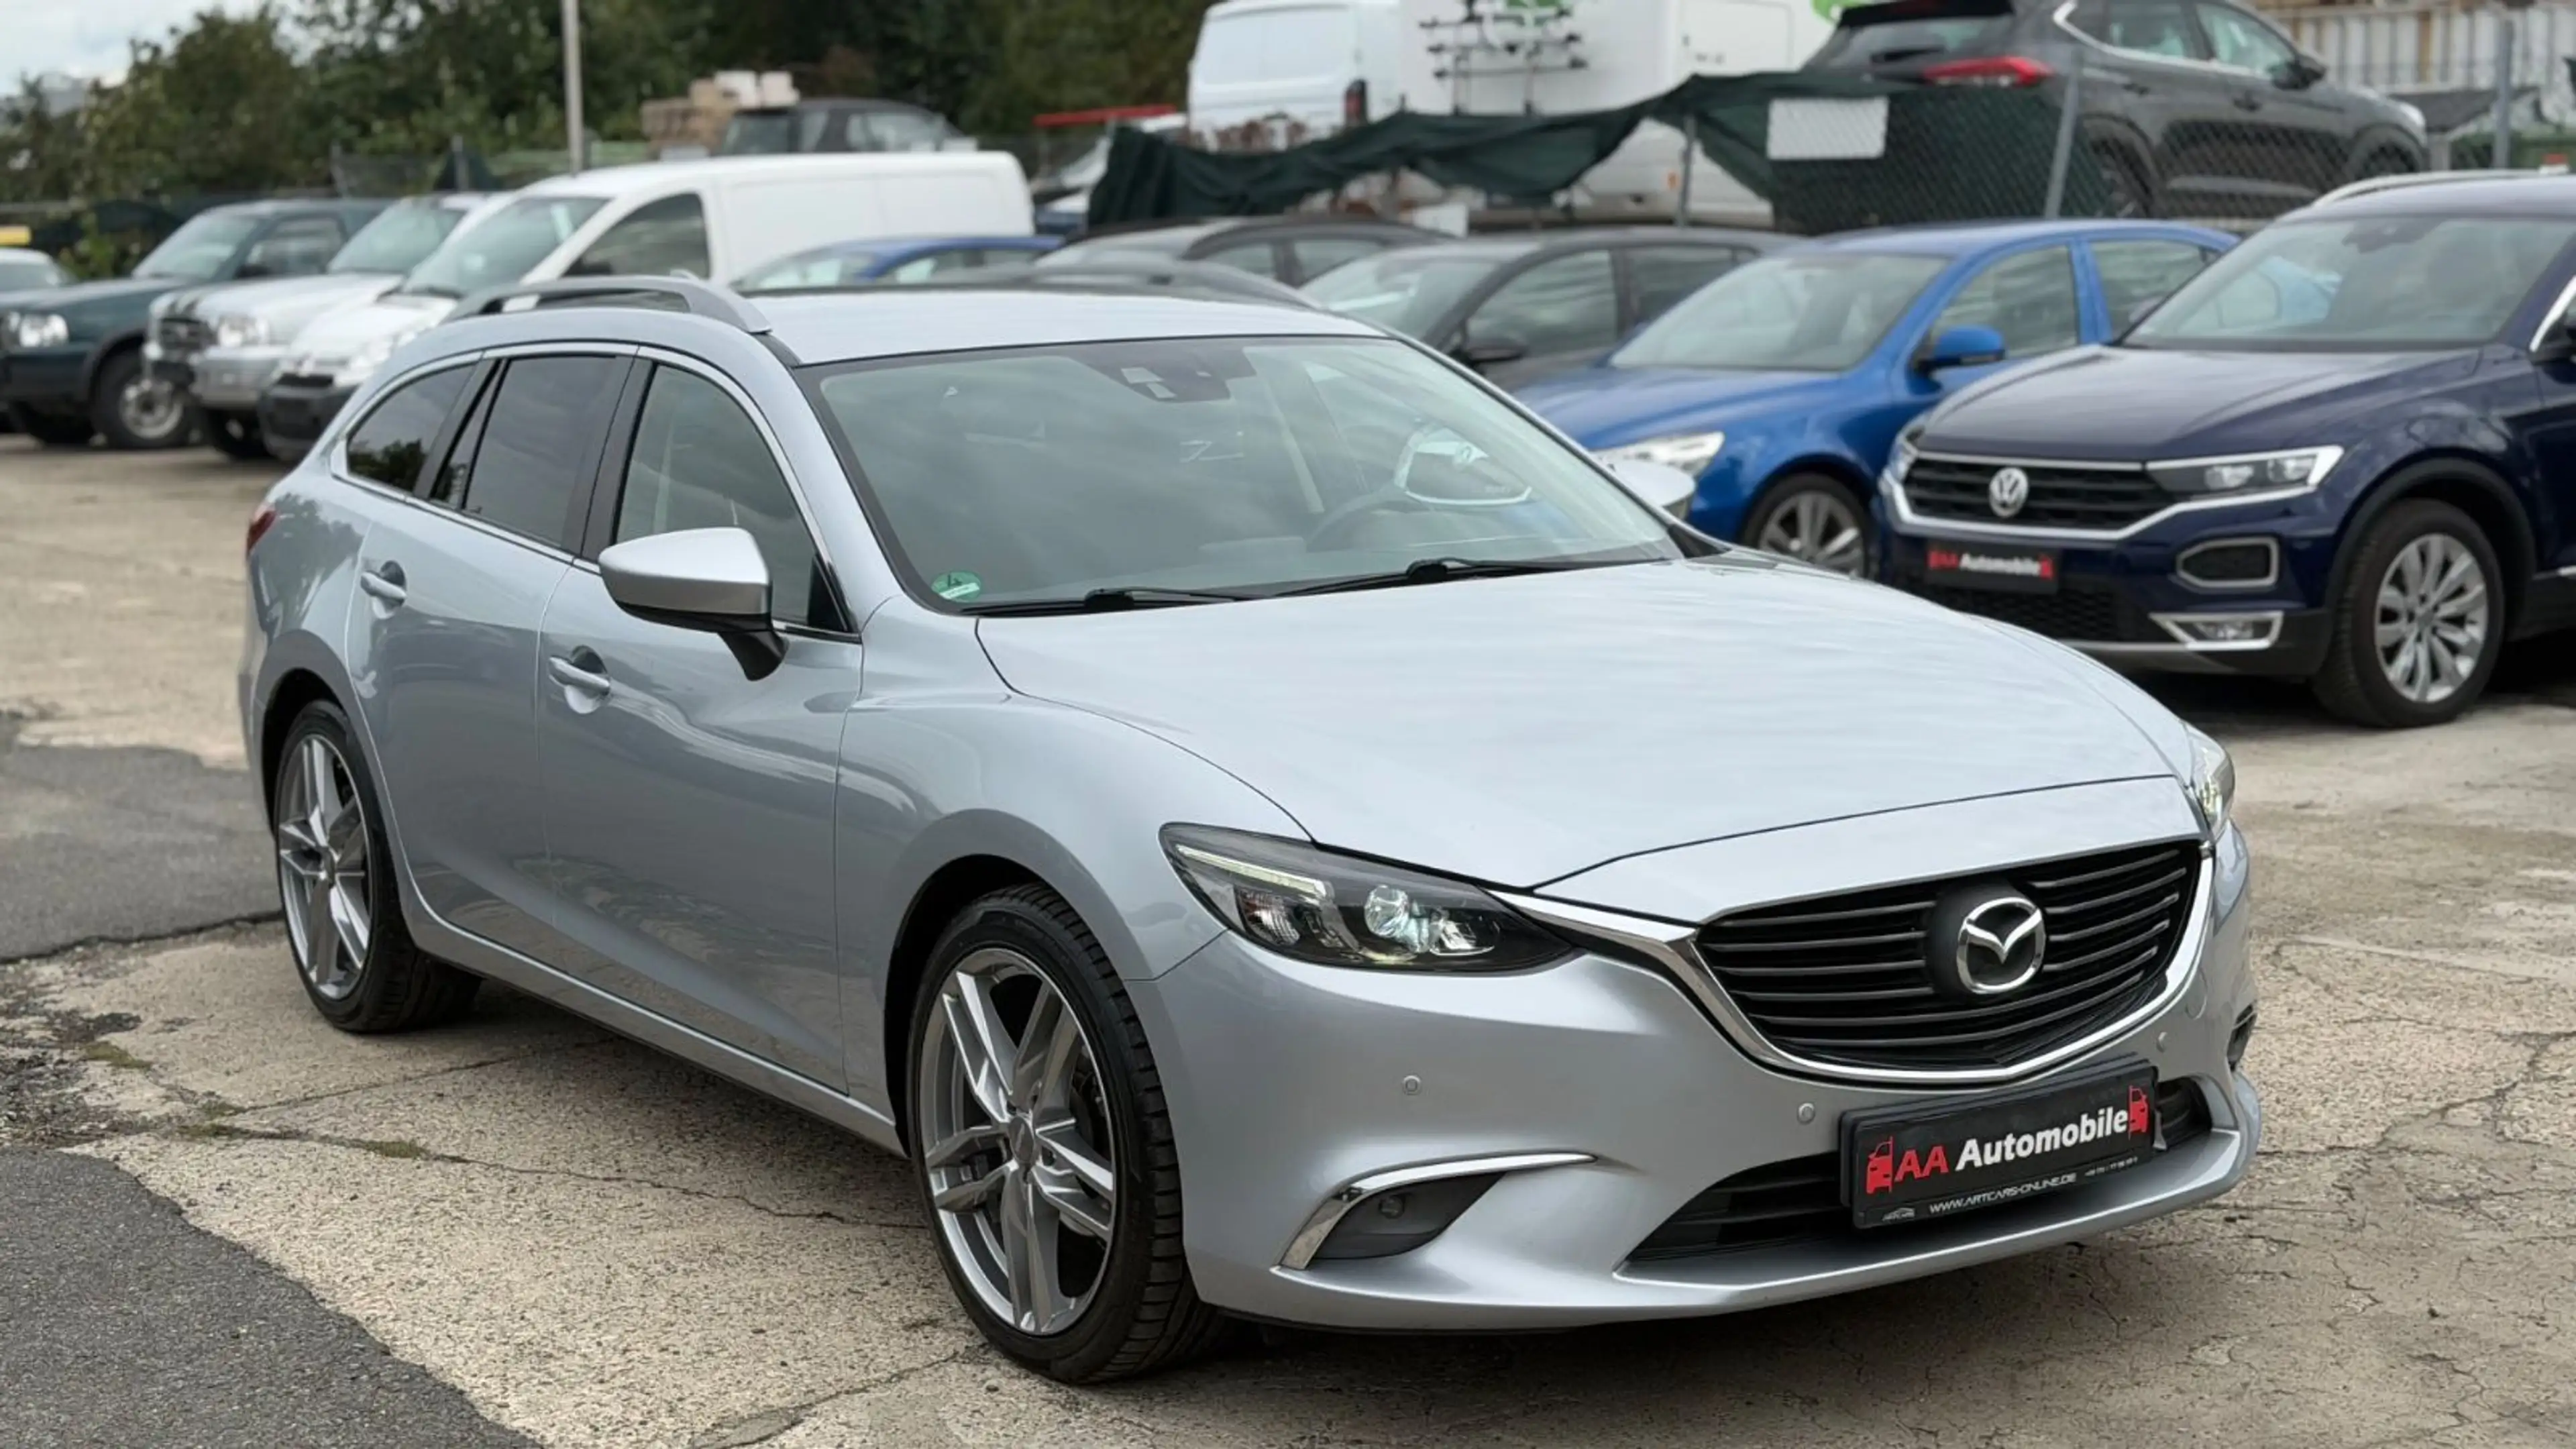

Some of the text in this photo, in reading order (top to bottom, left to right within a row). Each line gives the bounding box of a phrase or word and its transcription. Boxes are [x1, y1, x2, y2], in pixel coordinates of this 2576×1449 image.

[1990, 468, 2027, 515] VW
[947, 574, 963, 588] 4
[1894, 1145, 1949, 1183] AA
[1955, 1106, 2129, 1171] Automobile
